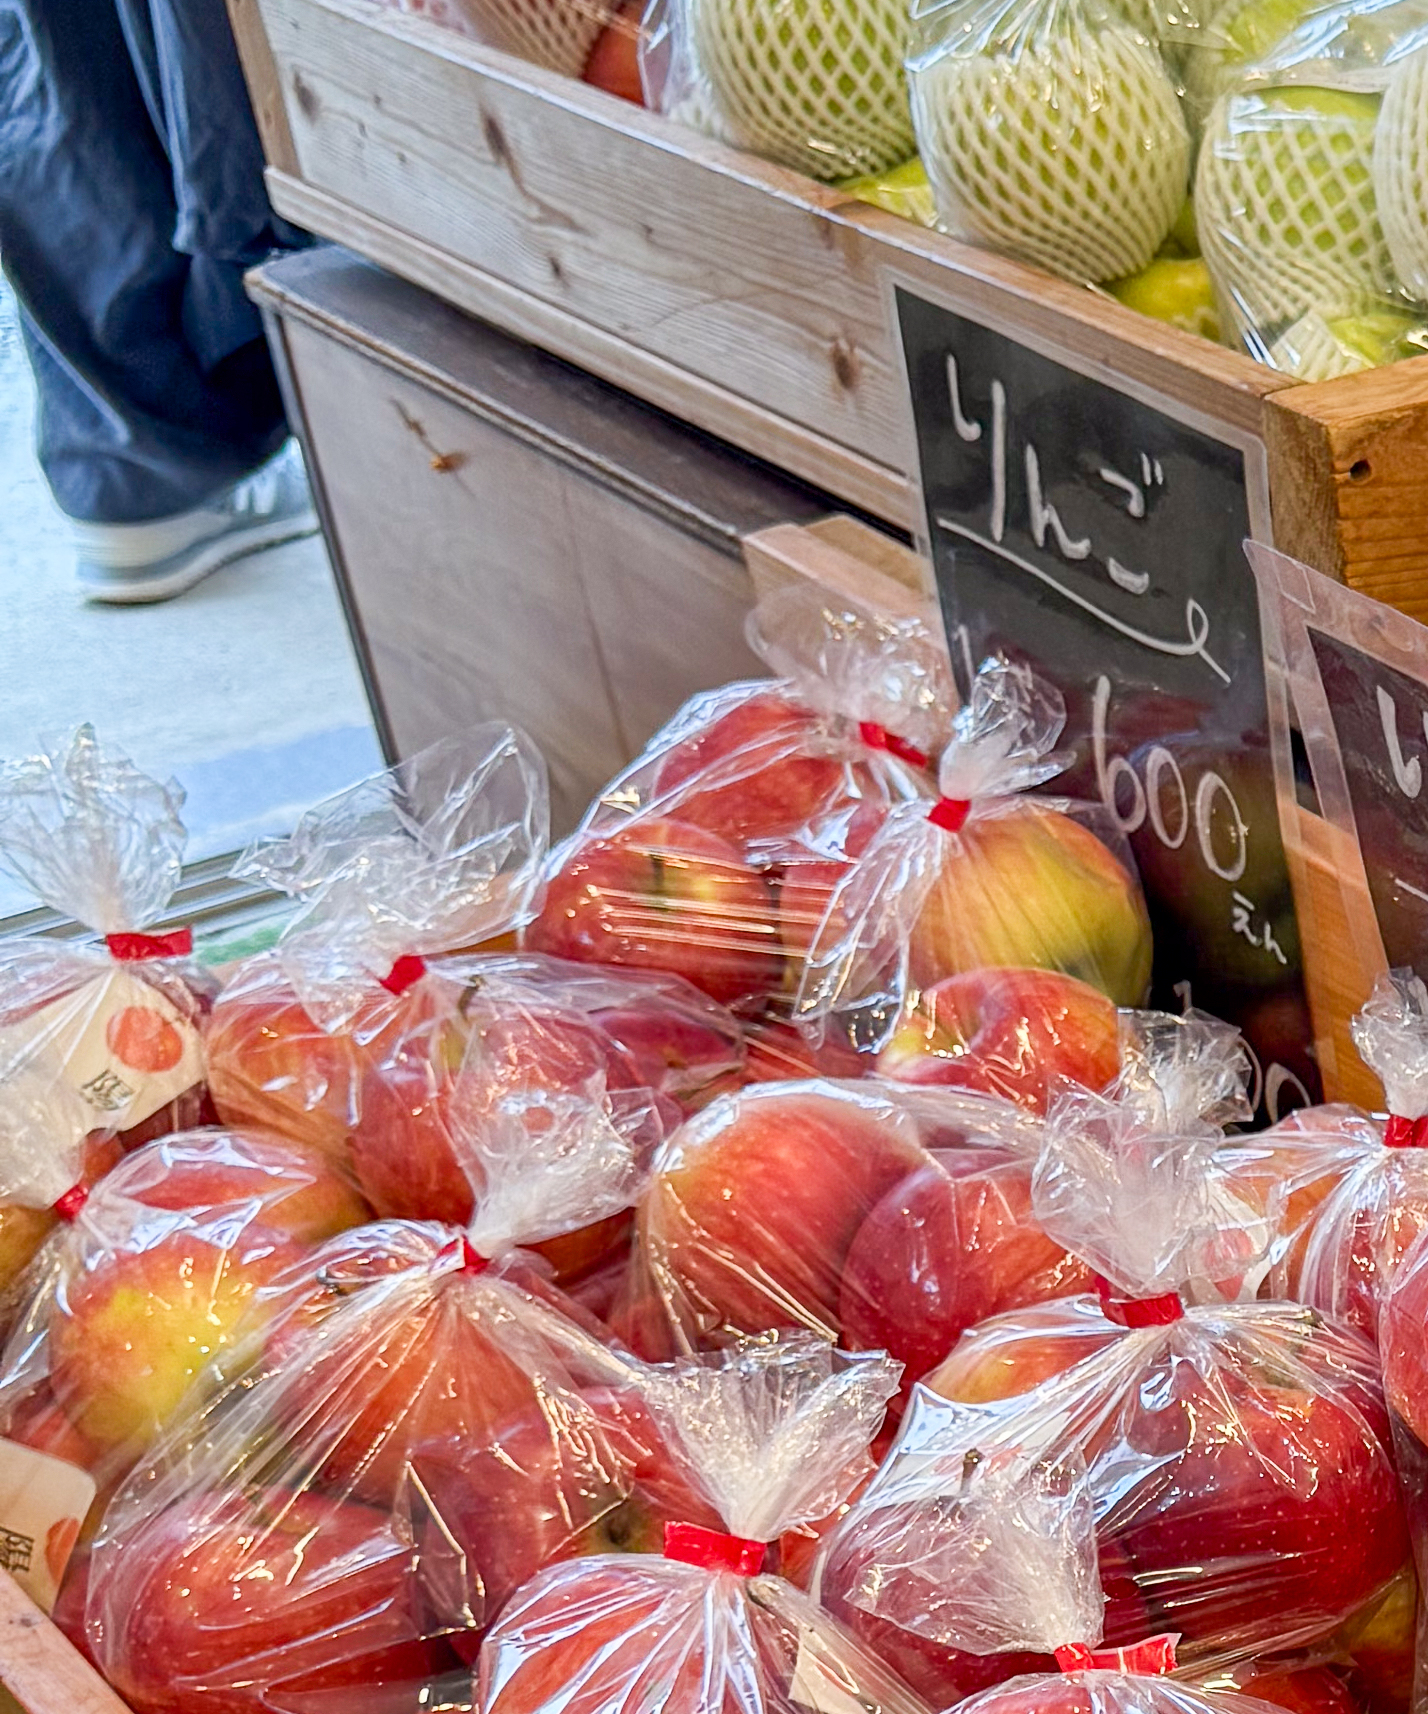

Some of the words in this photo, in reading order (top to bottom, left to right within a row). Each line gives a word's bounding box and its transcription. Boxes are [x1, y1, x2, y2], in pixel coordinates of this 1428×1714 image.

[946, 354, 1163, 593] りんご
[1093, 675, 1248, 882] 600
[1232, 891, 1287, 965] えん
